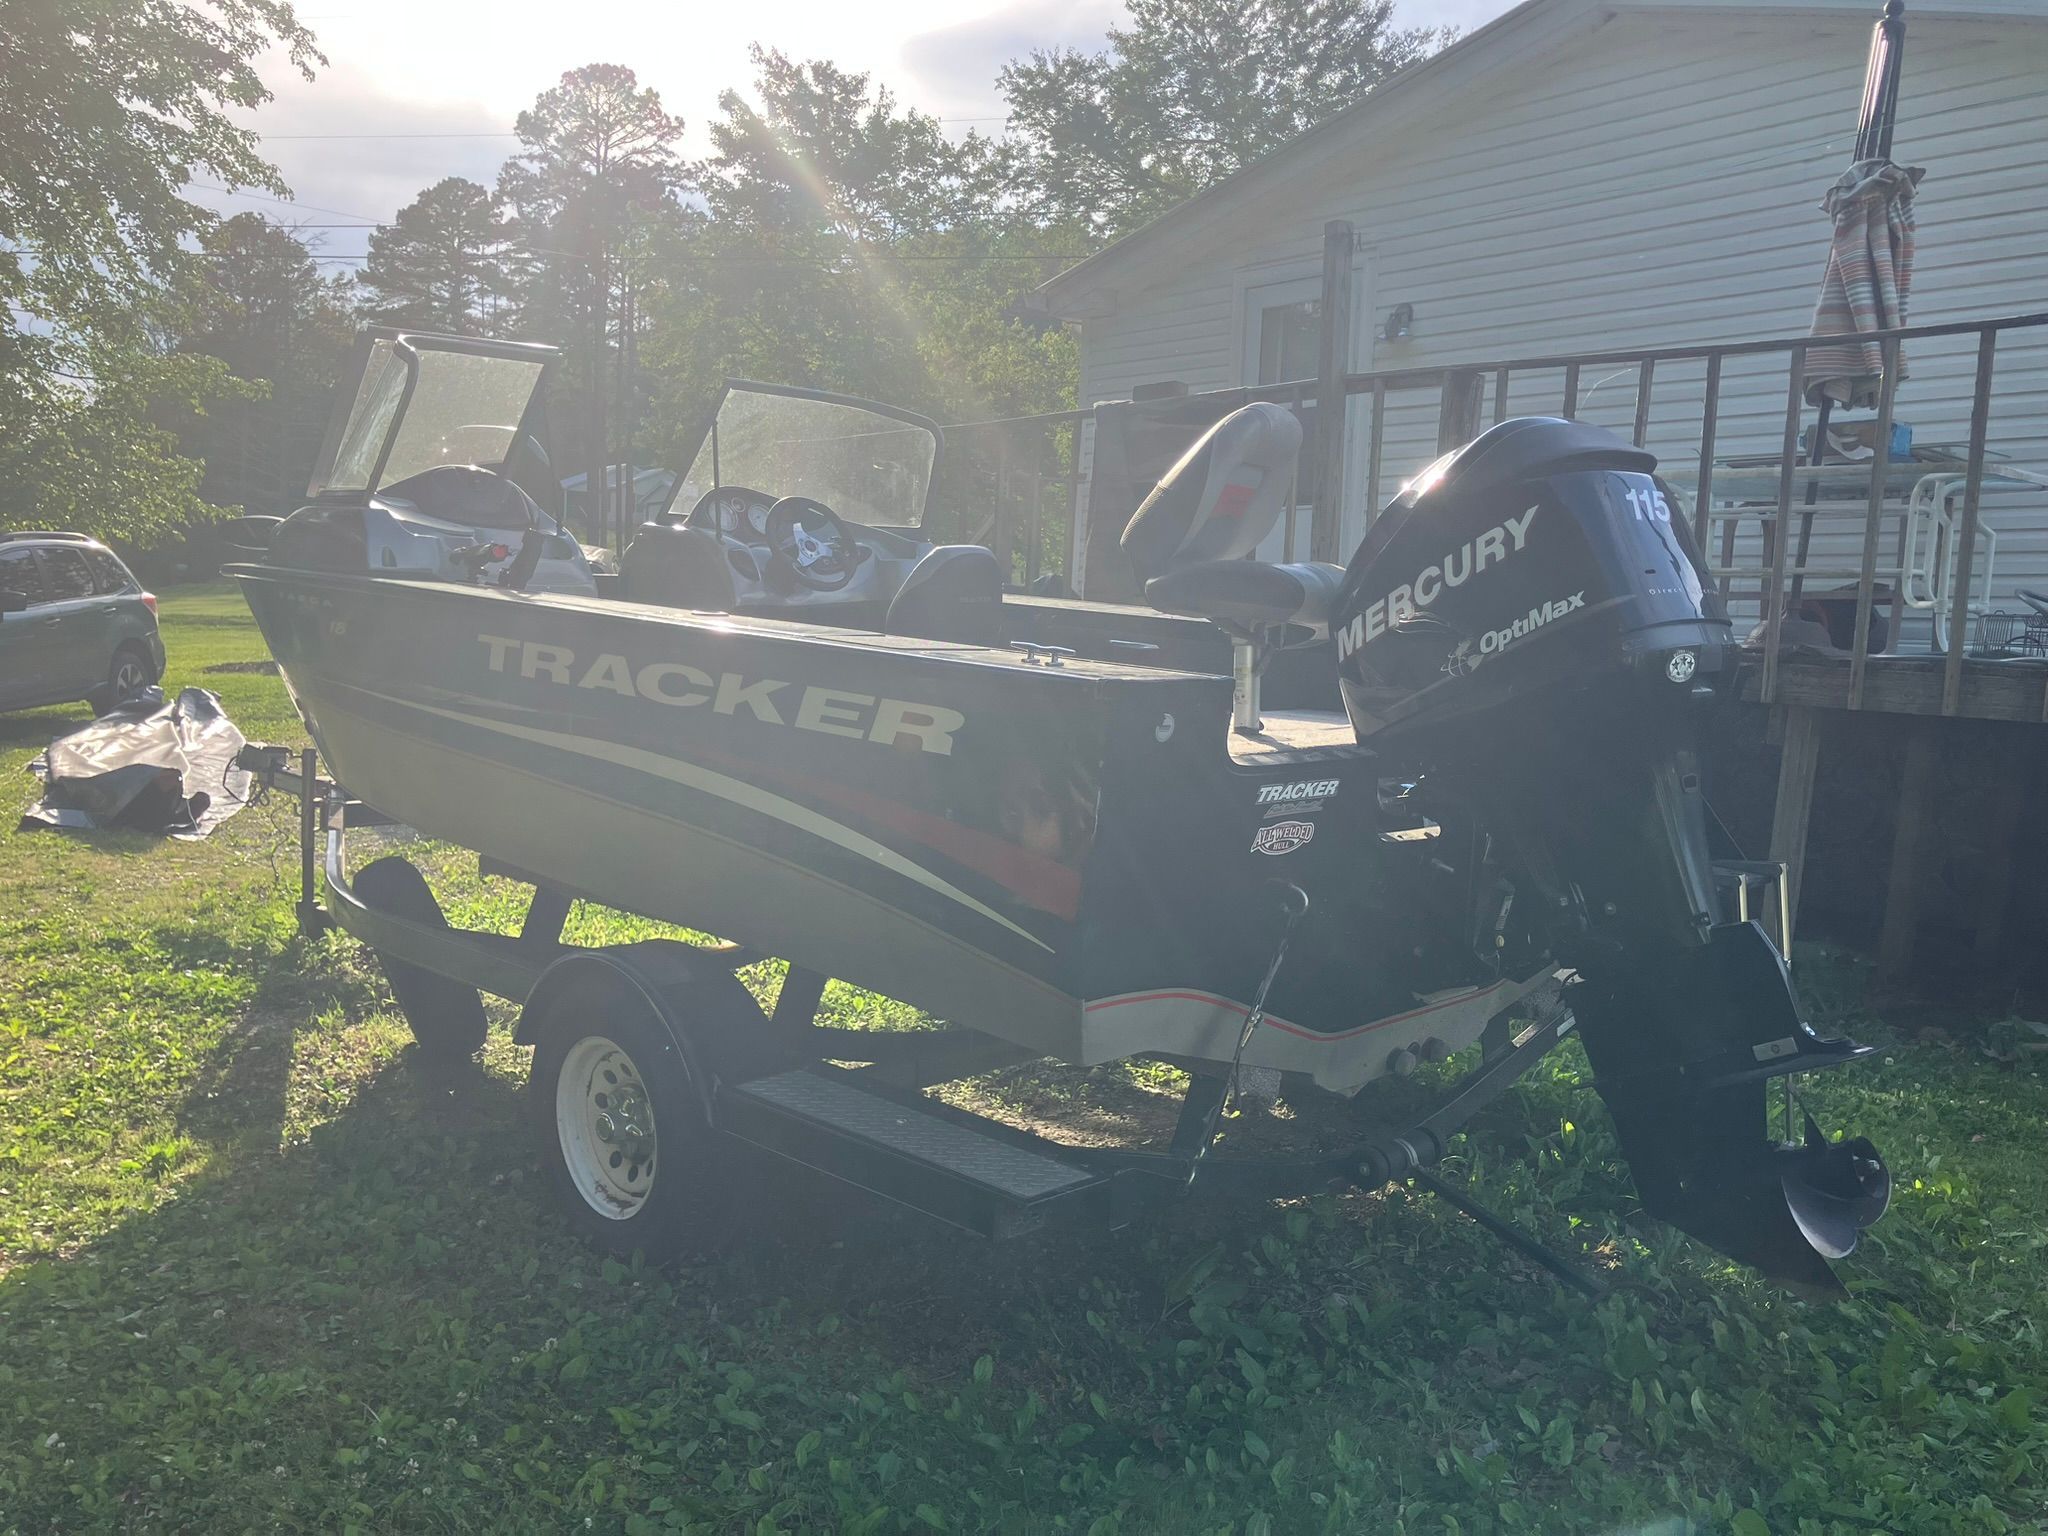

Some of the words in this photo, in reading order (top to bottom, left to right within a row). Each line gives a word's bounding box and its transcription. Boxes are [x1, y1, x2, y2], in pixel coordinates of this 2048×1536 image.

[1625, 488, 1670, 524] 115
[1338, 504, 1540, 662] MERCURY
[1480, 590, 1585, 655] OptiMax
[478, 634, 967, 757] TRACKER
[1257, 780, 1340, 803] TRACKER
